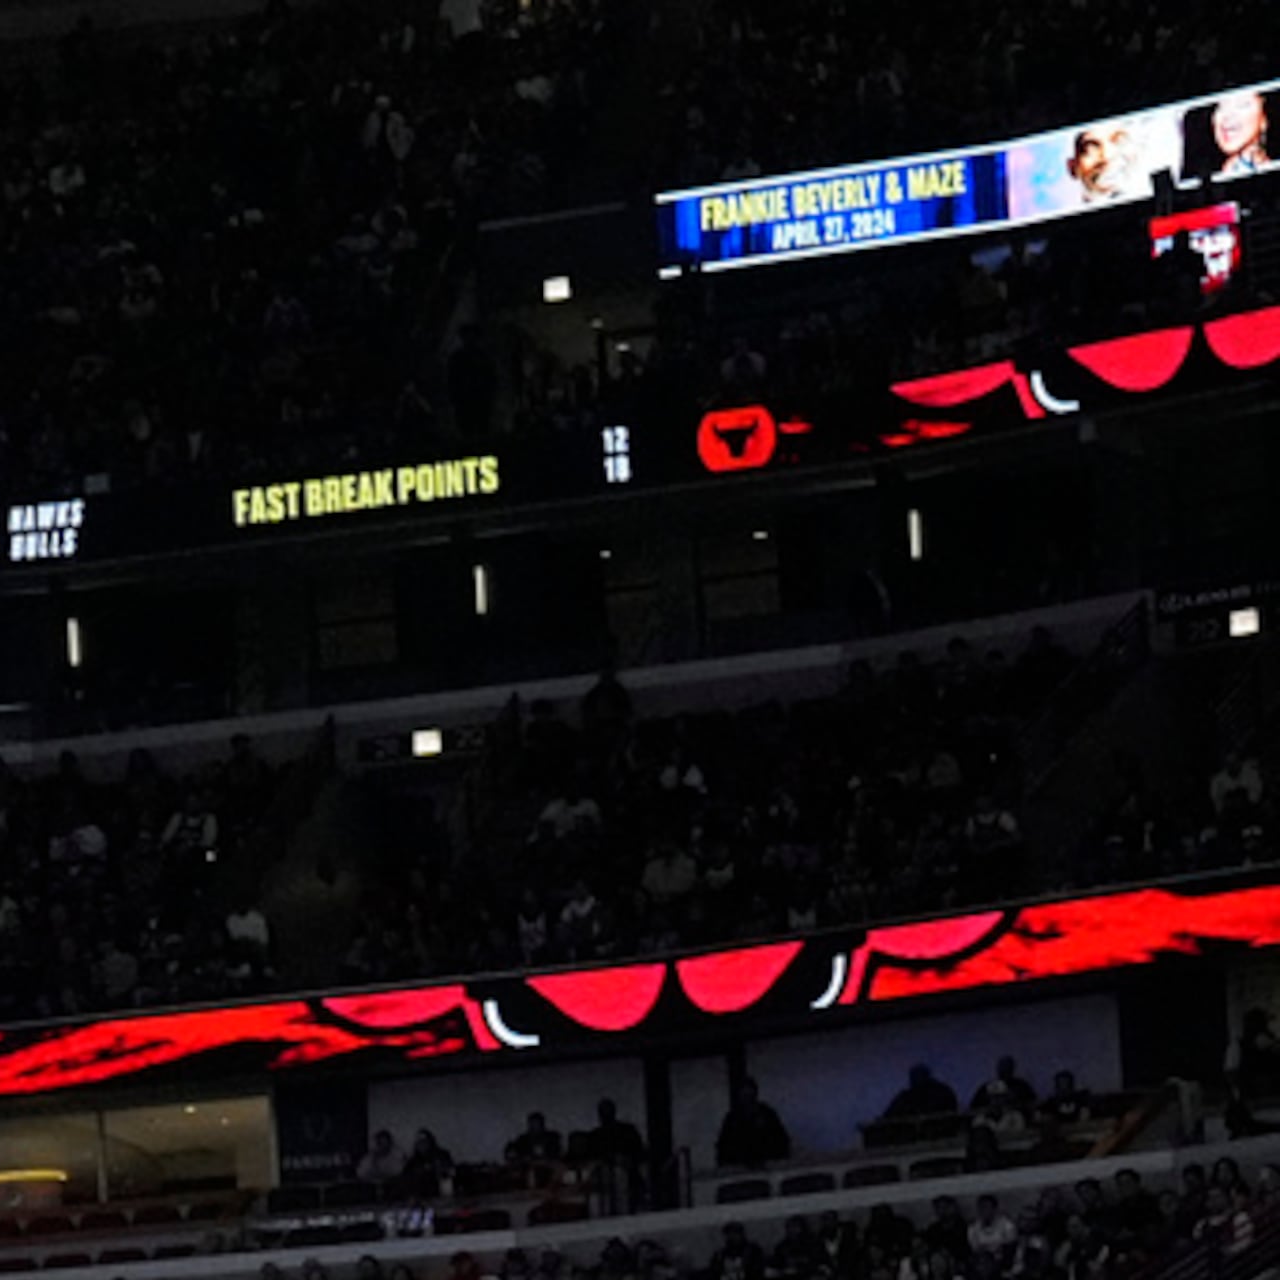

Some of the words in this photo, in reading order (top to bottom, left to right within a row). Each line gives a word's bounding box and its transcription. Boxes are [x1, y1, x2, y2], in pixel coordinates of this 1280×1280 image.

[700, 187, 789, 231] FRANKIE
[791, 173, 880, 216] BEVERLY
[885, 170, 903, 206] &
[906, 160, 967, 201] MAZE
[771, 216, 820, 251] APRIL
[233, 482, 300, 527] FAST
[304, 468, 395, 517] BREAK
[396, 455, 499, 504] POINTS
[7, 499, 84, 533] HAWKS
[10, 528, 77, 562] BULLS
